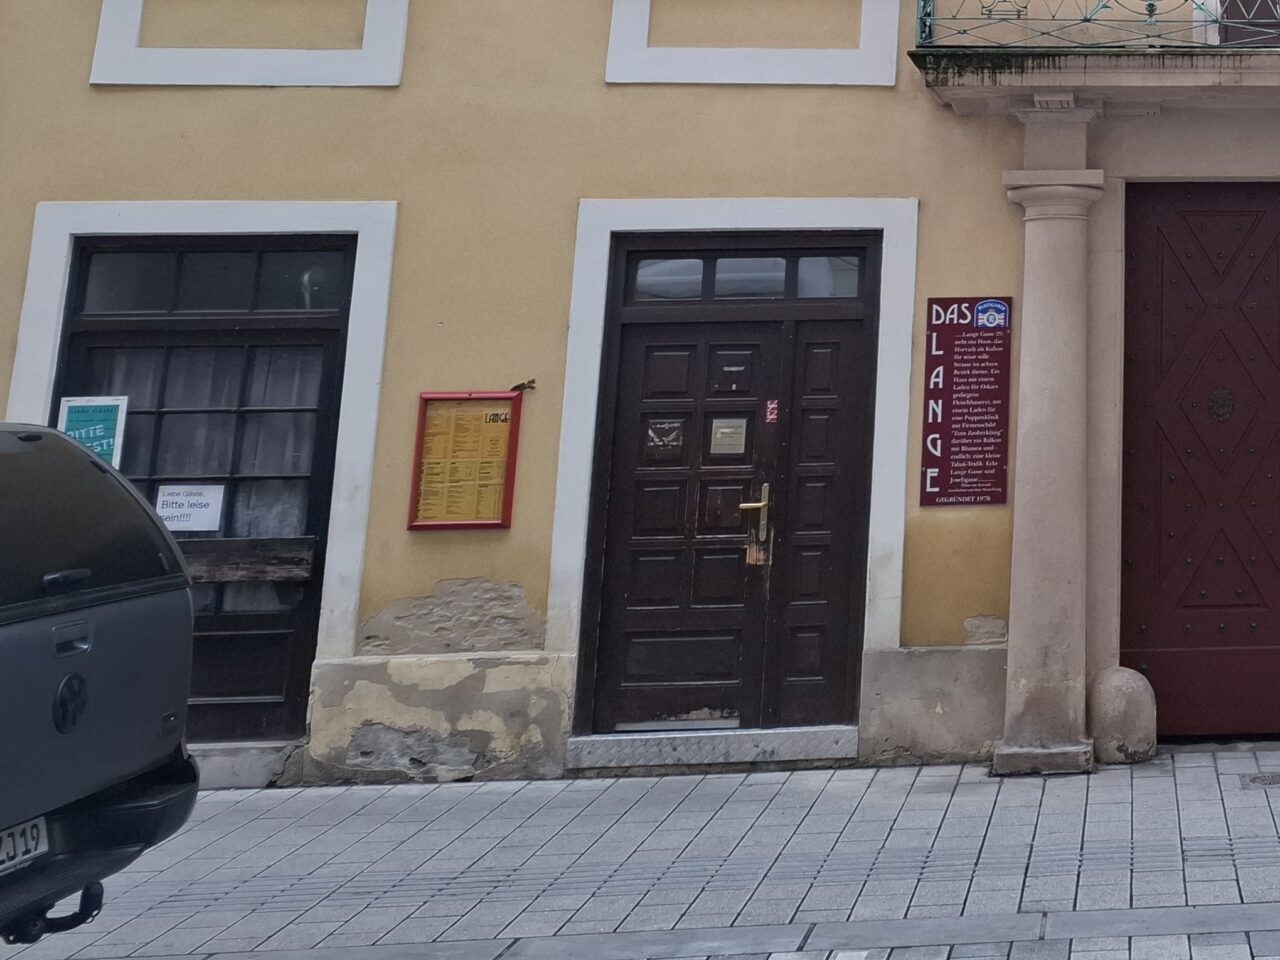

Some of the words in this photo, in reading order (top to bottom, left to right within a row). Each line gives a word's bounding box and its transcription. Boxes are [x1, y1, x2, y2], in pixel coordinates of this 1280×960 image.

[932, 303, 971, 324] DAS
[161, 500, 184, 509] Bitte
[187, 500, 210, 509] leise
